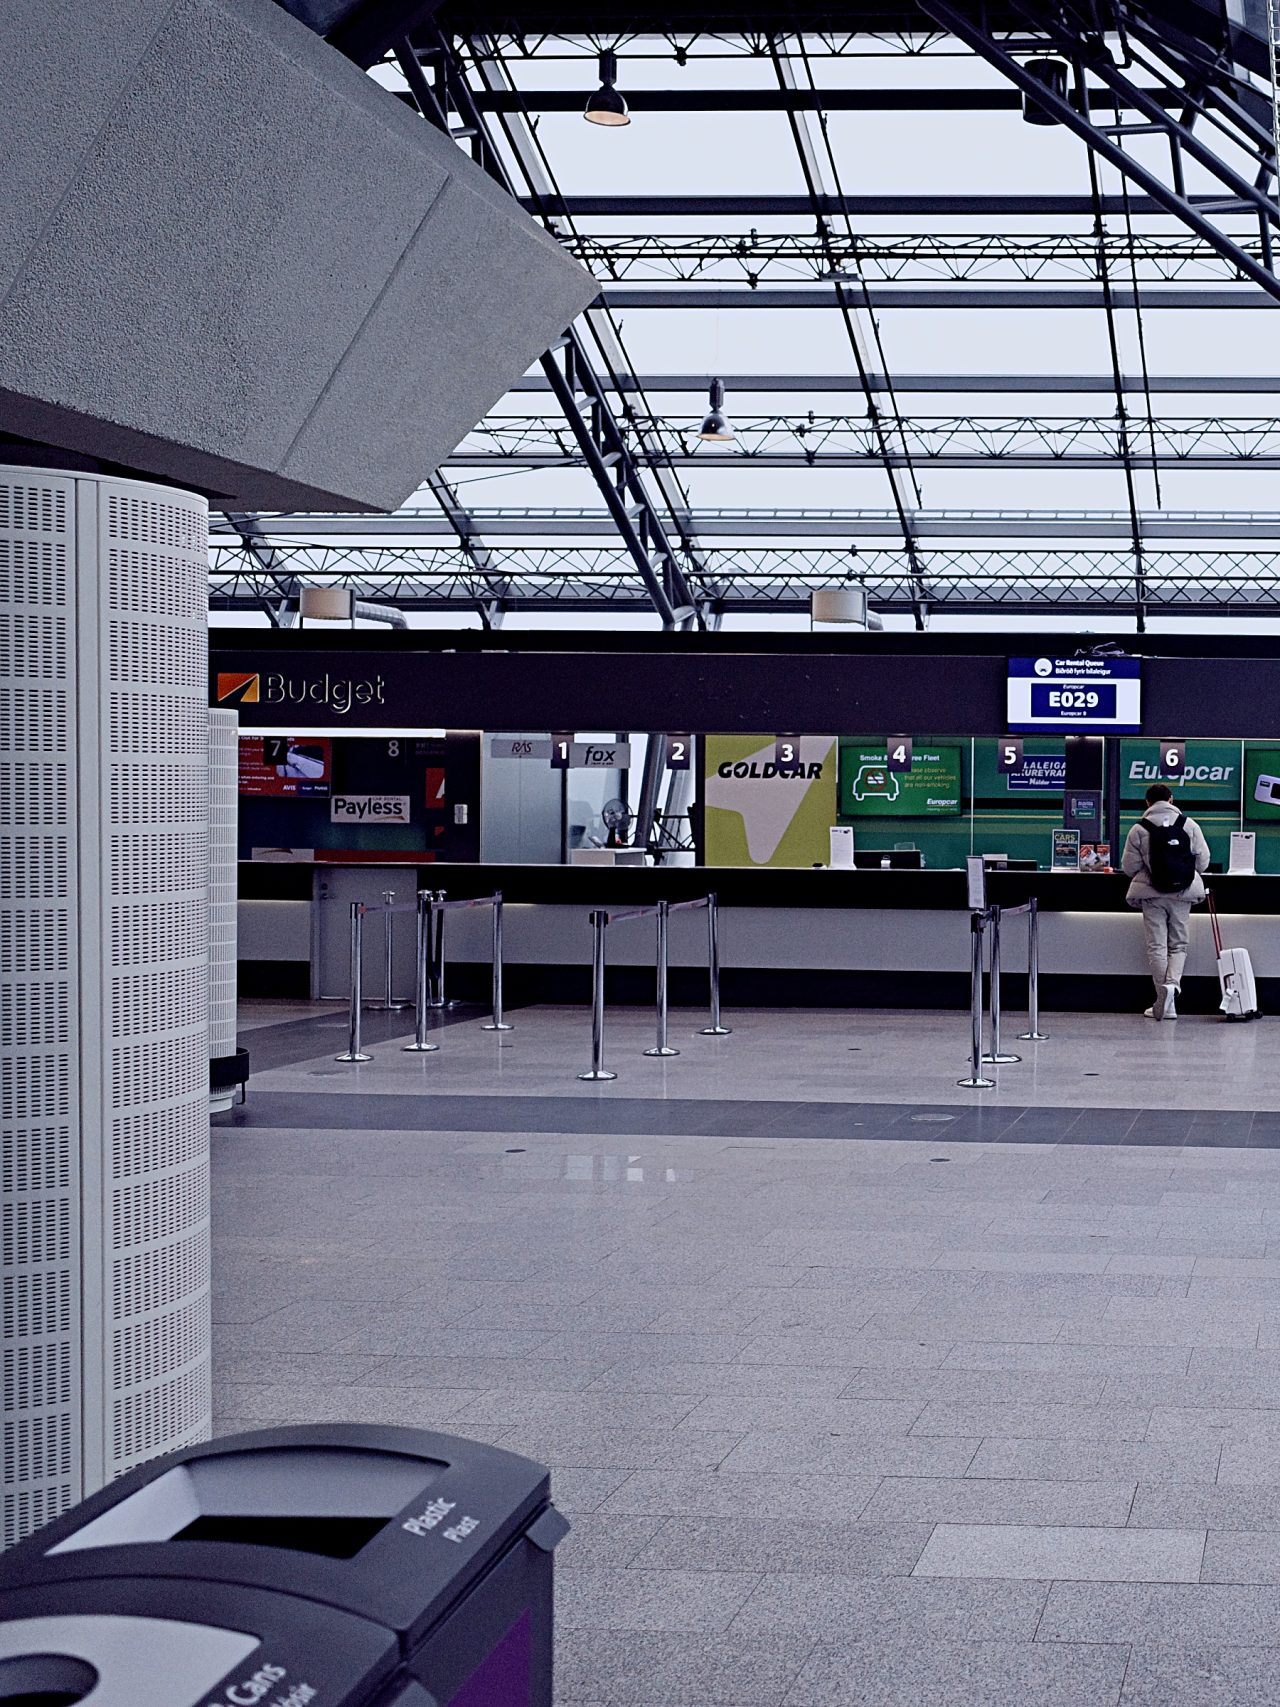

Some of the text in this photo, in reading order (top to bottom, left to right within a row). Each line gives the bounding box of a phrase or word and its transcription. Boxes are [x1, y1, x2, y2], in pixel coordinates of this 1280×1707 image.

[1085, 660, 1105, 668] Queue
[265, 673, 385, 714] Budget
[1049, 691, 1099, 708] E029
[270, 740, 281, 756] 7
[388, 740, 399, 757] 8
[558, 741, 567, 760] 1
[584, 746, 617, 765] fox
[672, 742, 685, 761] 2
[781, 744, 794, 762] 3
[892, 745, 907, 763] 4
[1004, 746, 1017, 765] 5
[1165, 748, 1179, 767] 6
[1128, 761, 1234, 786] Eupcar
[334, 797, 403, 819] Payless
[926, 798, 958, 806] Europcar
[402, 1497, 457, 1537] Plastic
[443, 1516, 480, 1543] Plast
[226, 1663, 286, 1706] Cans
